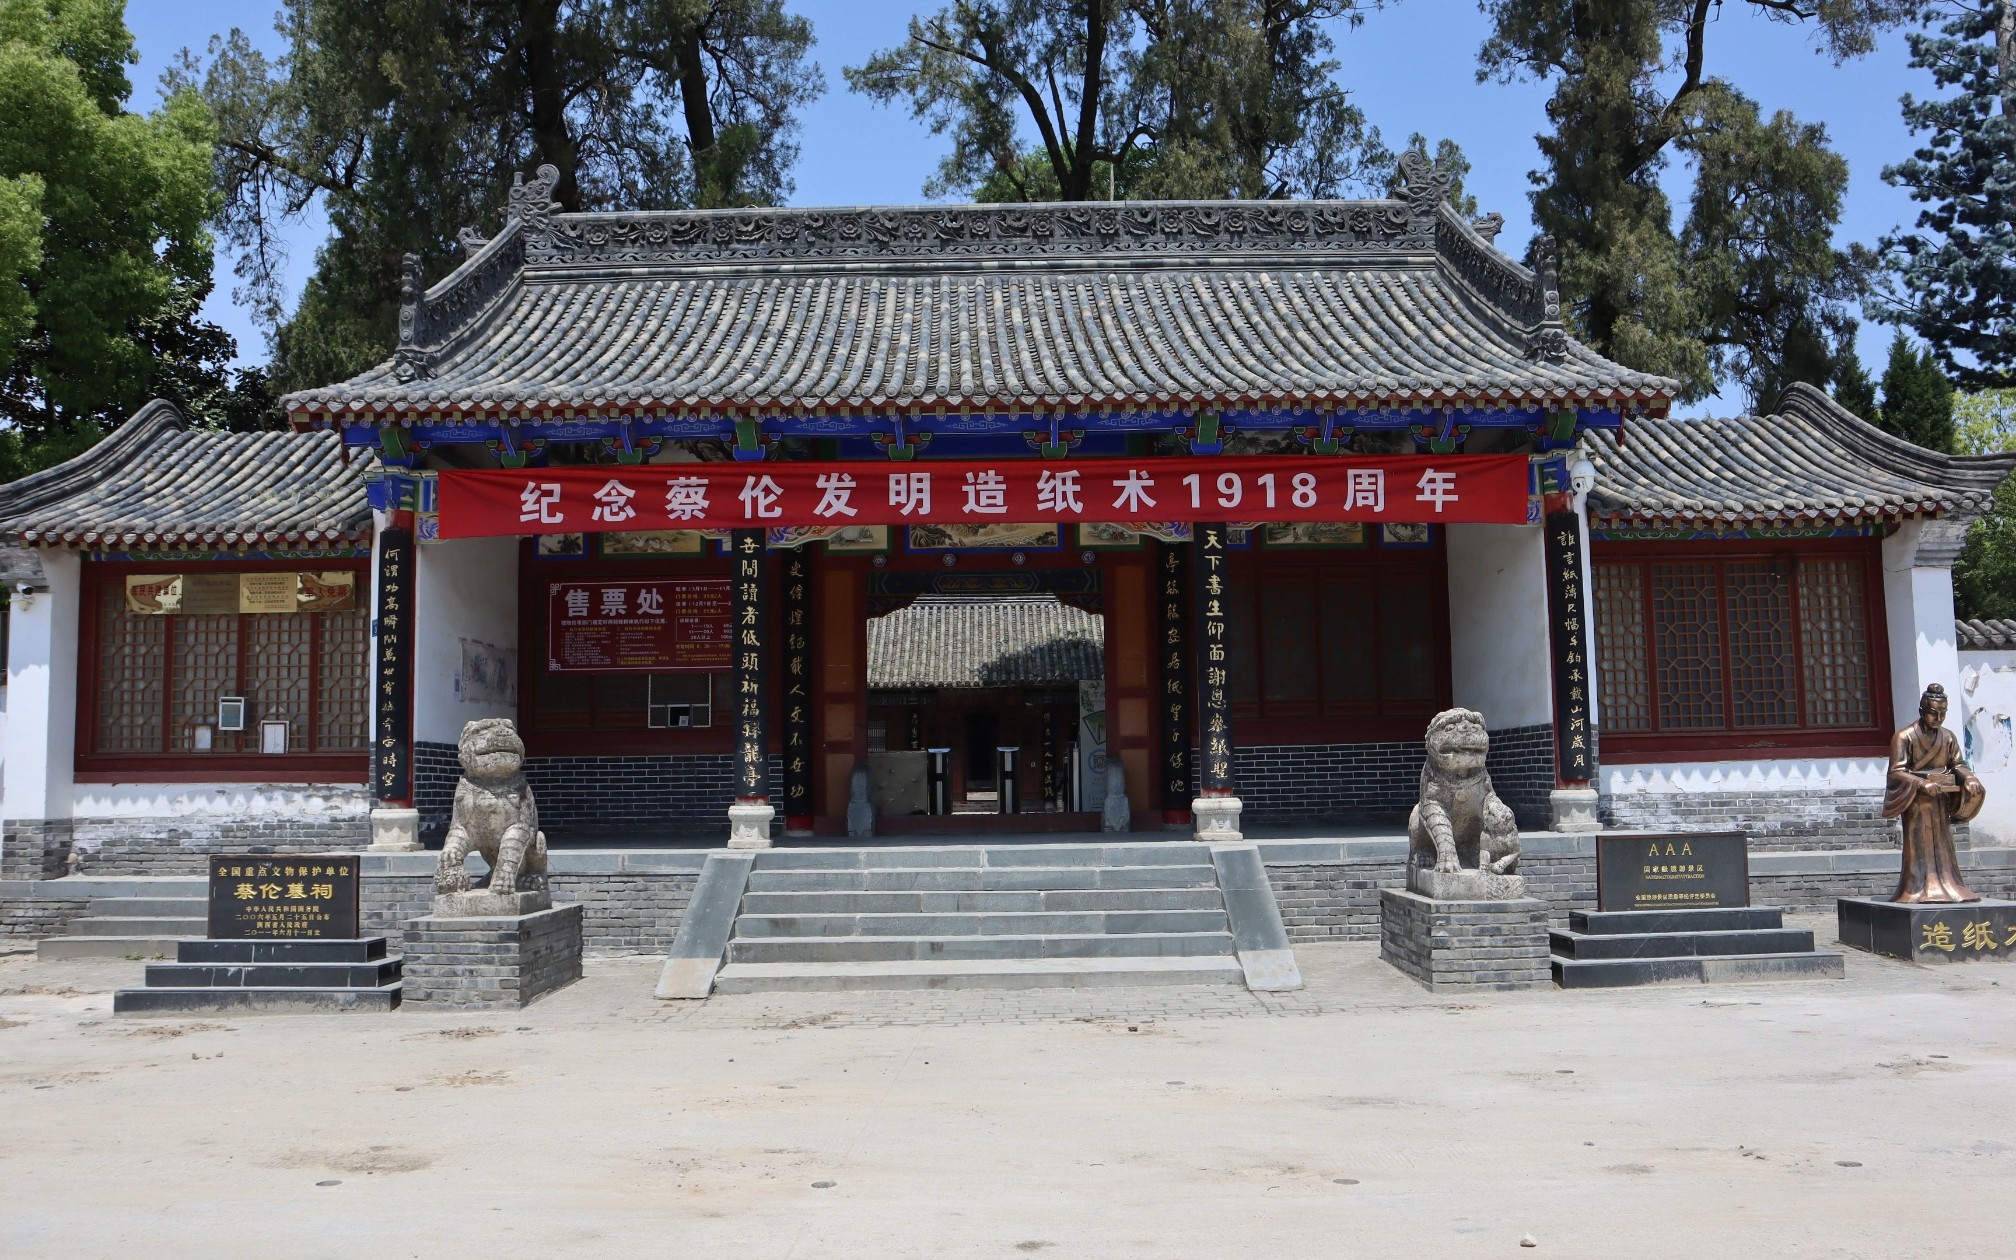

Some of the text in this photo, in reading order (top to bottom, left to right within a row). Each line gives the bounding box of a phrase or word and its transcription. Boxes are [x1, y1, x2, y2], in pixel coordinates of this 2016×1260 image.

[519, 467, 1459, 524] 纪念蔡伦发明造纸术1918周年
[565, 588, 664, 617] 售票处
[217, 866, 349, 877] 全国重点文物保护单位
[1643, 864, 1704, 873] 国家级旅游景区
[233, 882, 333, 900] 蔡伦墓祠
[245, 905, 320, 913] 中华人民共和国国务院
[256, 921, 308, 929] 陕西省人民政府
